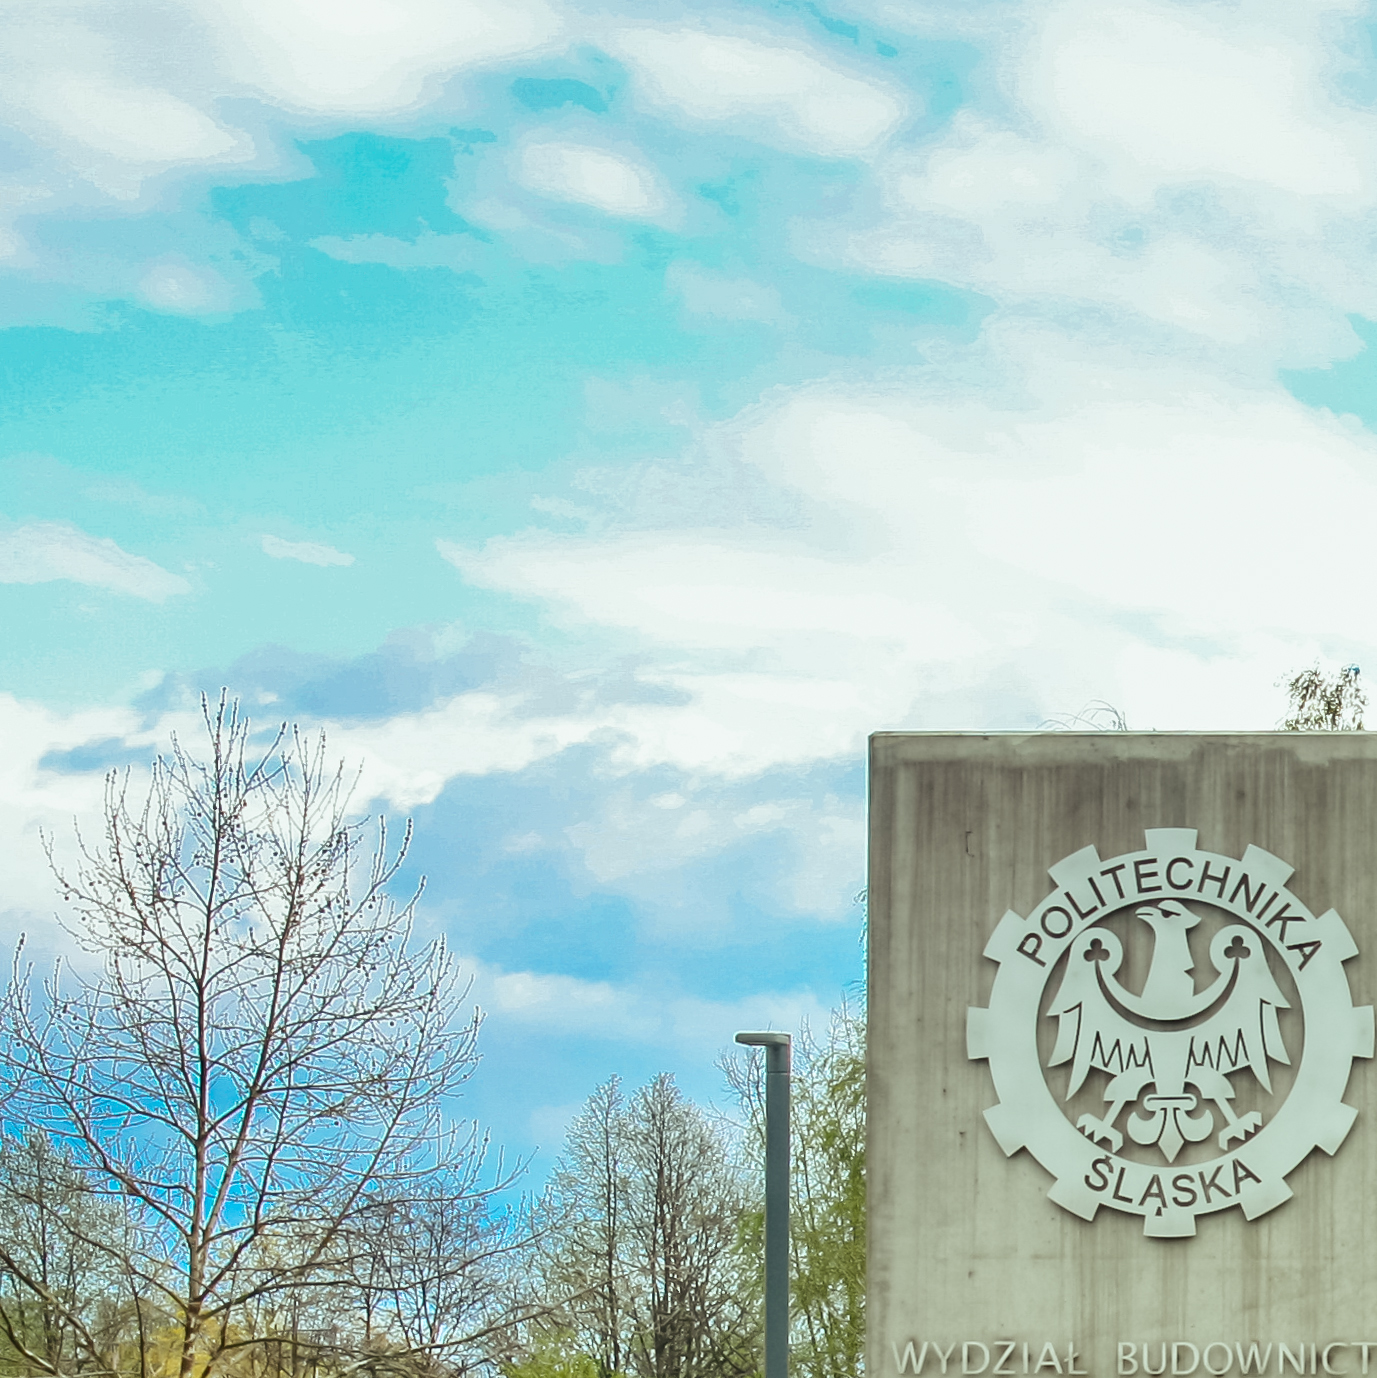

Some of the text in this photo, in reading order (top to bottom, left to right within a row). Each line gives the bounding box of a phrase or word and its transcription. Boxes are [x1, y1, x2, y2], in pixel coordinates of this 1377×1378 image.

[1016, 857, 1323, 972] POLITECHNIKA
[1084, 1155, 1262, 1216] ŚLĄSKA
[892, 1340, 1088, 1376] WYDZIAŁ
